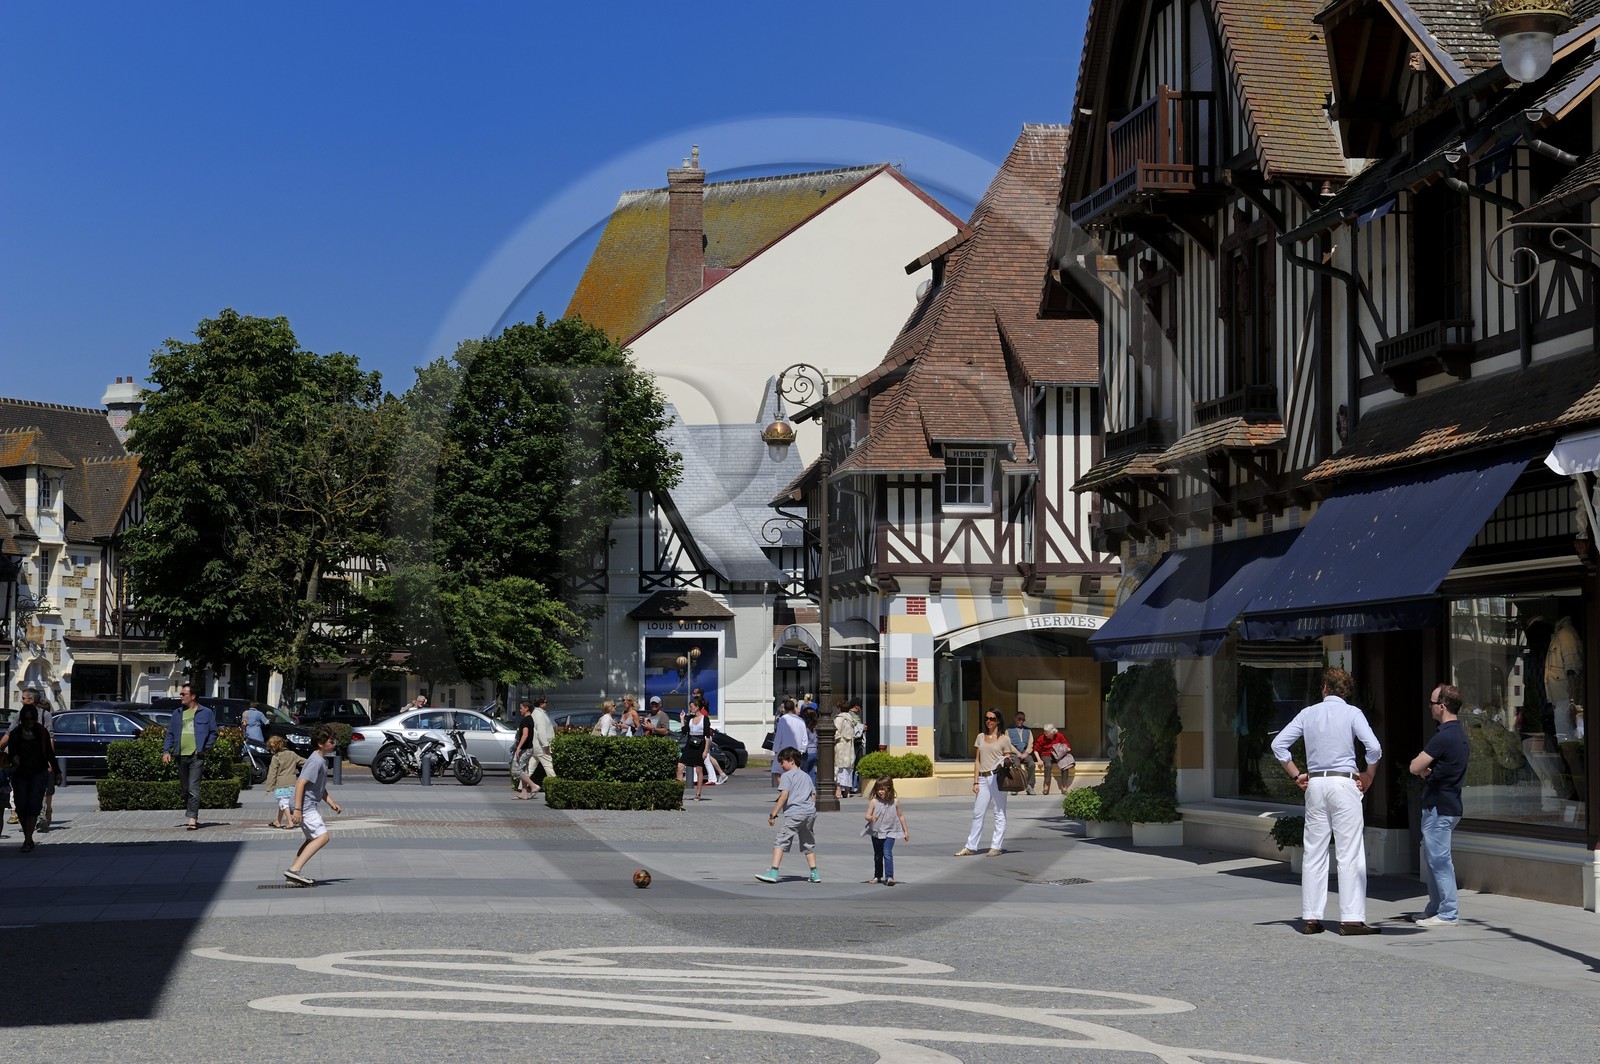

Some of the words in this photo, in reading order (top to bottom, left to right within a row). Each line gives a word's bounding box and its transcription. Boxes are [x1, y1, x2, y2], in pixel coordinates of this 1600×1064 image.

[647, 622, 674, 631] LOUIS
[678, 622, 717, 631] VUITTON
[1330, 613, 1366, 629] LAUREN
